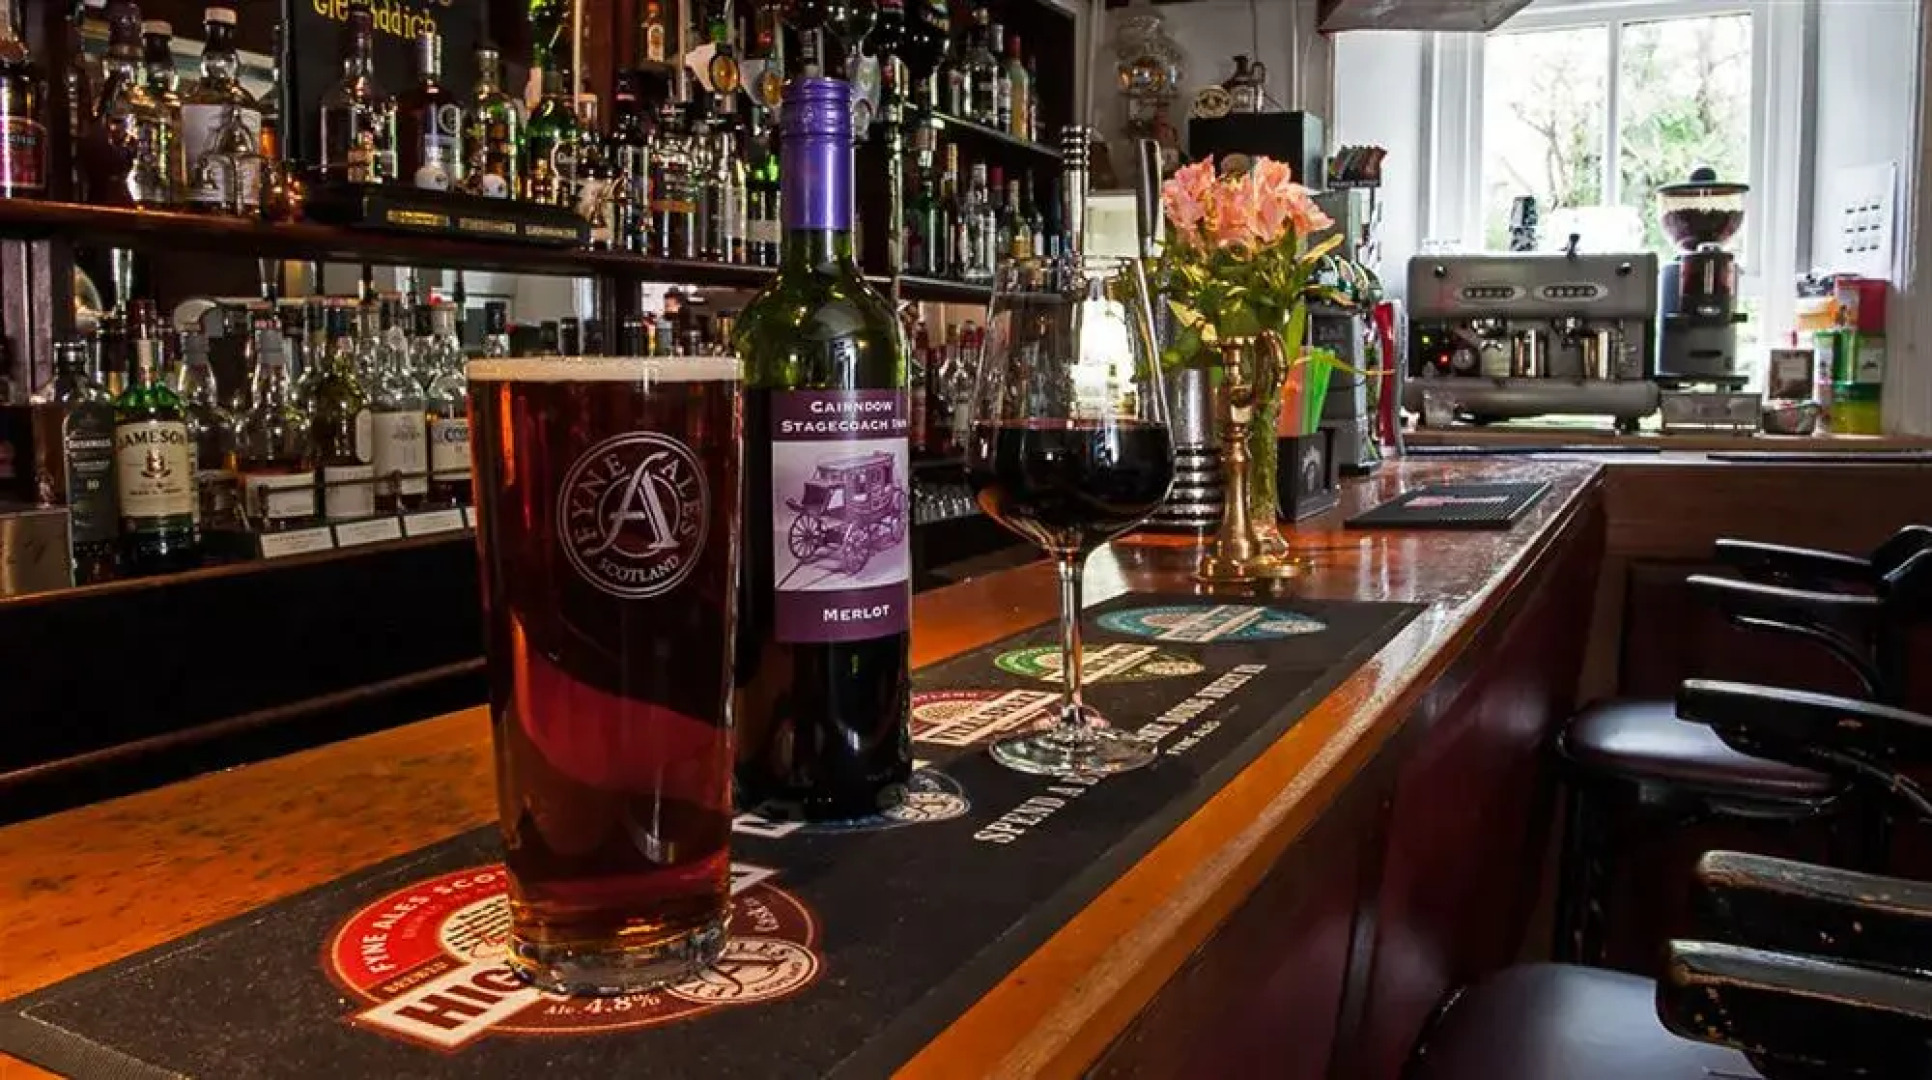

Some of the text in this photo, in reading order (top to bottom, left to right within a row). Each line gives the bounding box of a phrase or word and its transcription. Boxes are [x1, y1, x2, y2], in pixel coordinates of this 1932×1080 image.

[810, 401, 893, 413] CAIRNDOW
[782, 419, 888, 433] STAGECOACH
[571, 453, 699, 544] FYNE ALES
[599, 555, 679, 582] SCOTLAND
[823, 604, 890, 622] MERLOT
[973, 796, 1066, 844] SPEND
[372, 895, 430, 931] ALES
[361, 933, 396, 974] FYNE
